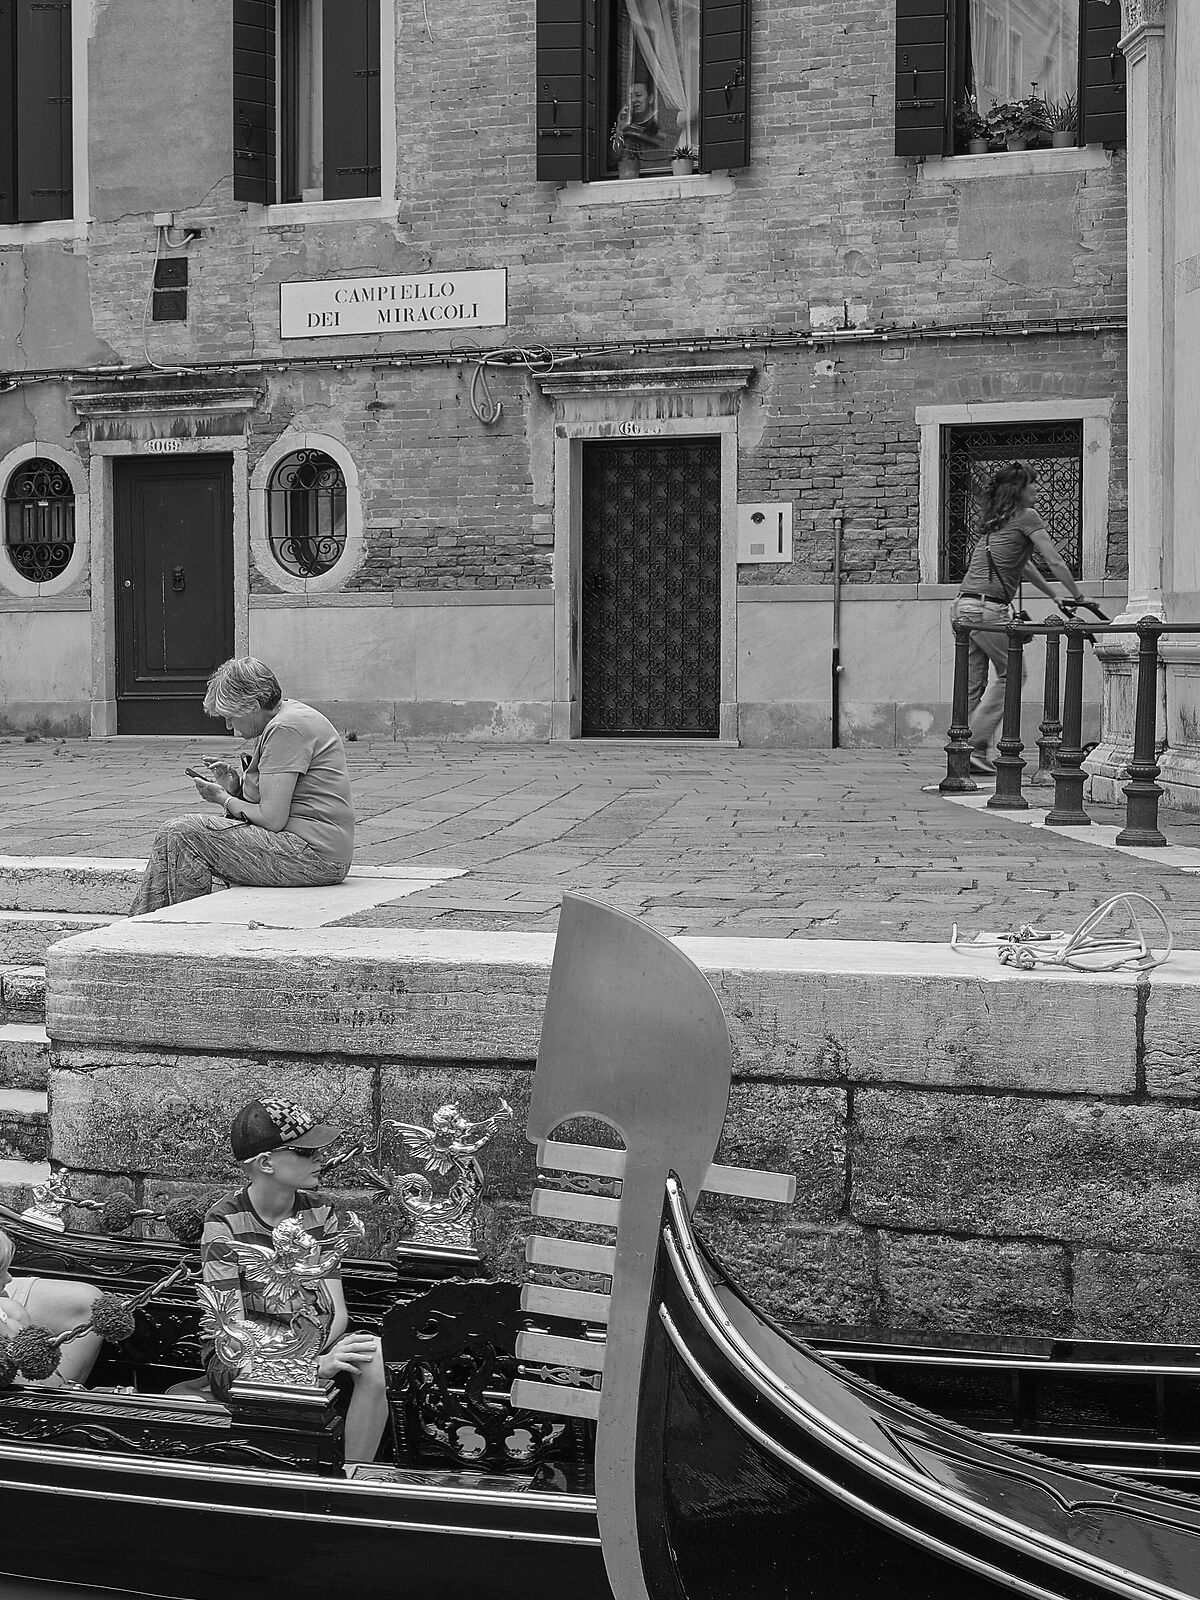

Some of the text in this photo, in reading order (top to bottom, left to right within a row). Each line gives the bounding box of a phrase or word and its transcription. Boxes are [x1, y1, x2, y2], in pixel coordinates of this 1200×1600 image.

[334, 281, 455, 304] CAMPIELLO
[307, 303, 479, 328] DEI MIRACOLI
[621, 422, 661, 434] 60
